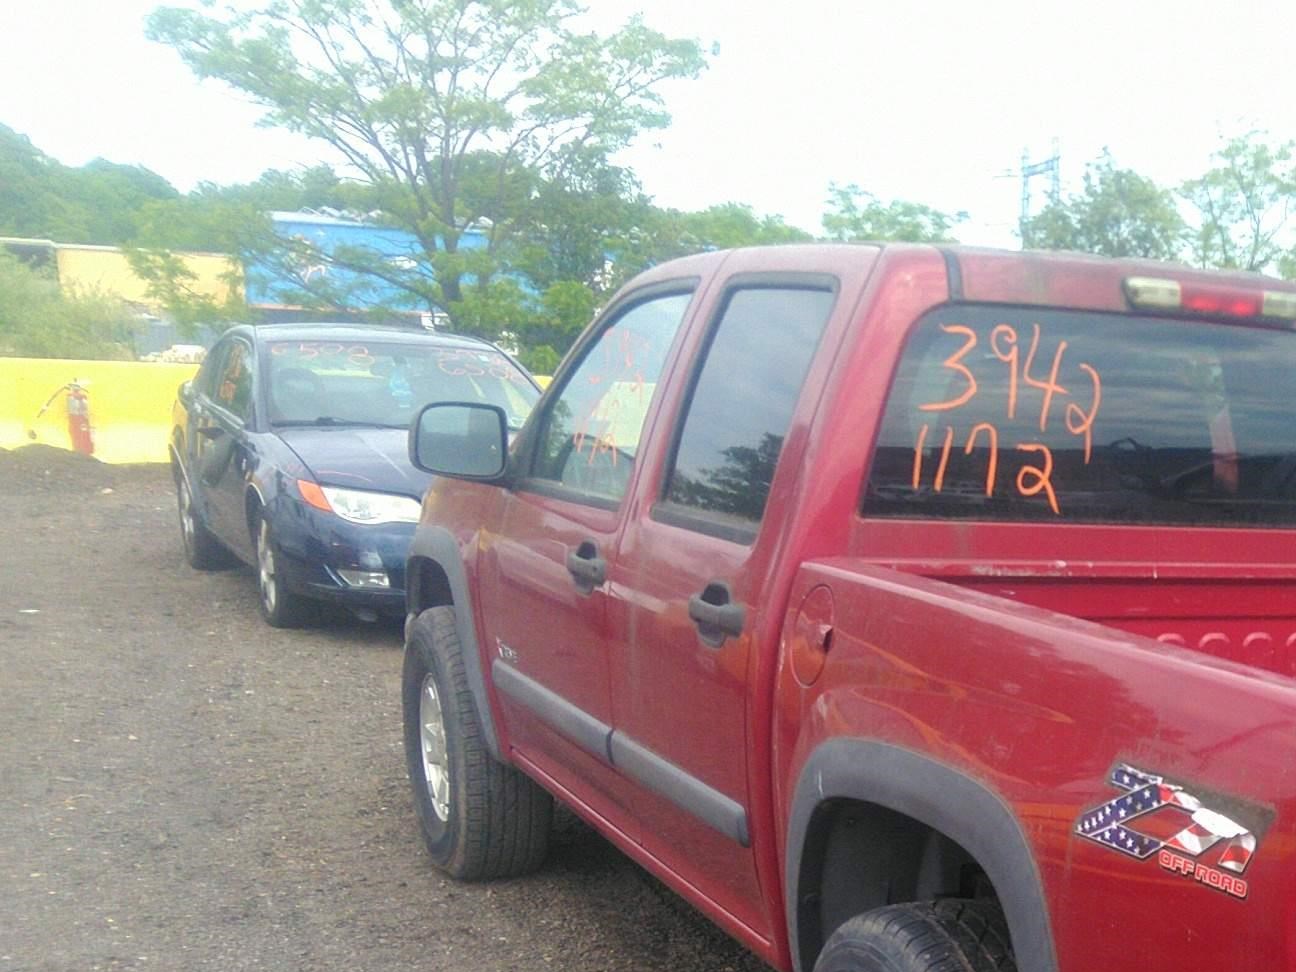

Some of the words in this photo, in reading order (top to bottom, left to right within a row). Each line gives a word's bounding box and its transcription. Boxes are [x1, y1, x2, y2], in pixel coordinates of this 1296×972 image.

[918, 323, 1101, 464] 3942
[912, 422, 1060, 516] 1172
[1158, 849, 1194, 876] OFF
[1195, 866, 1248, 899] ROAD
